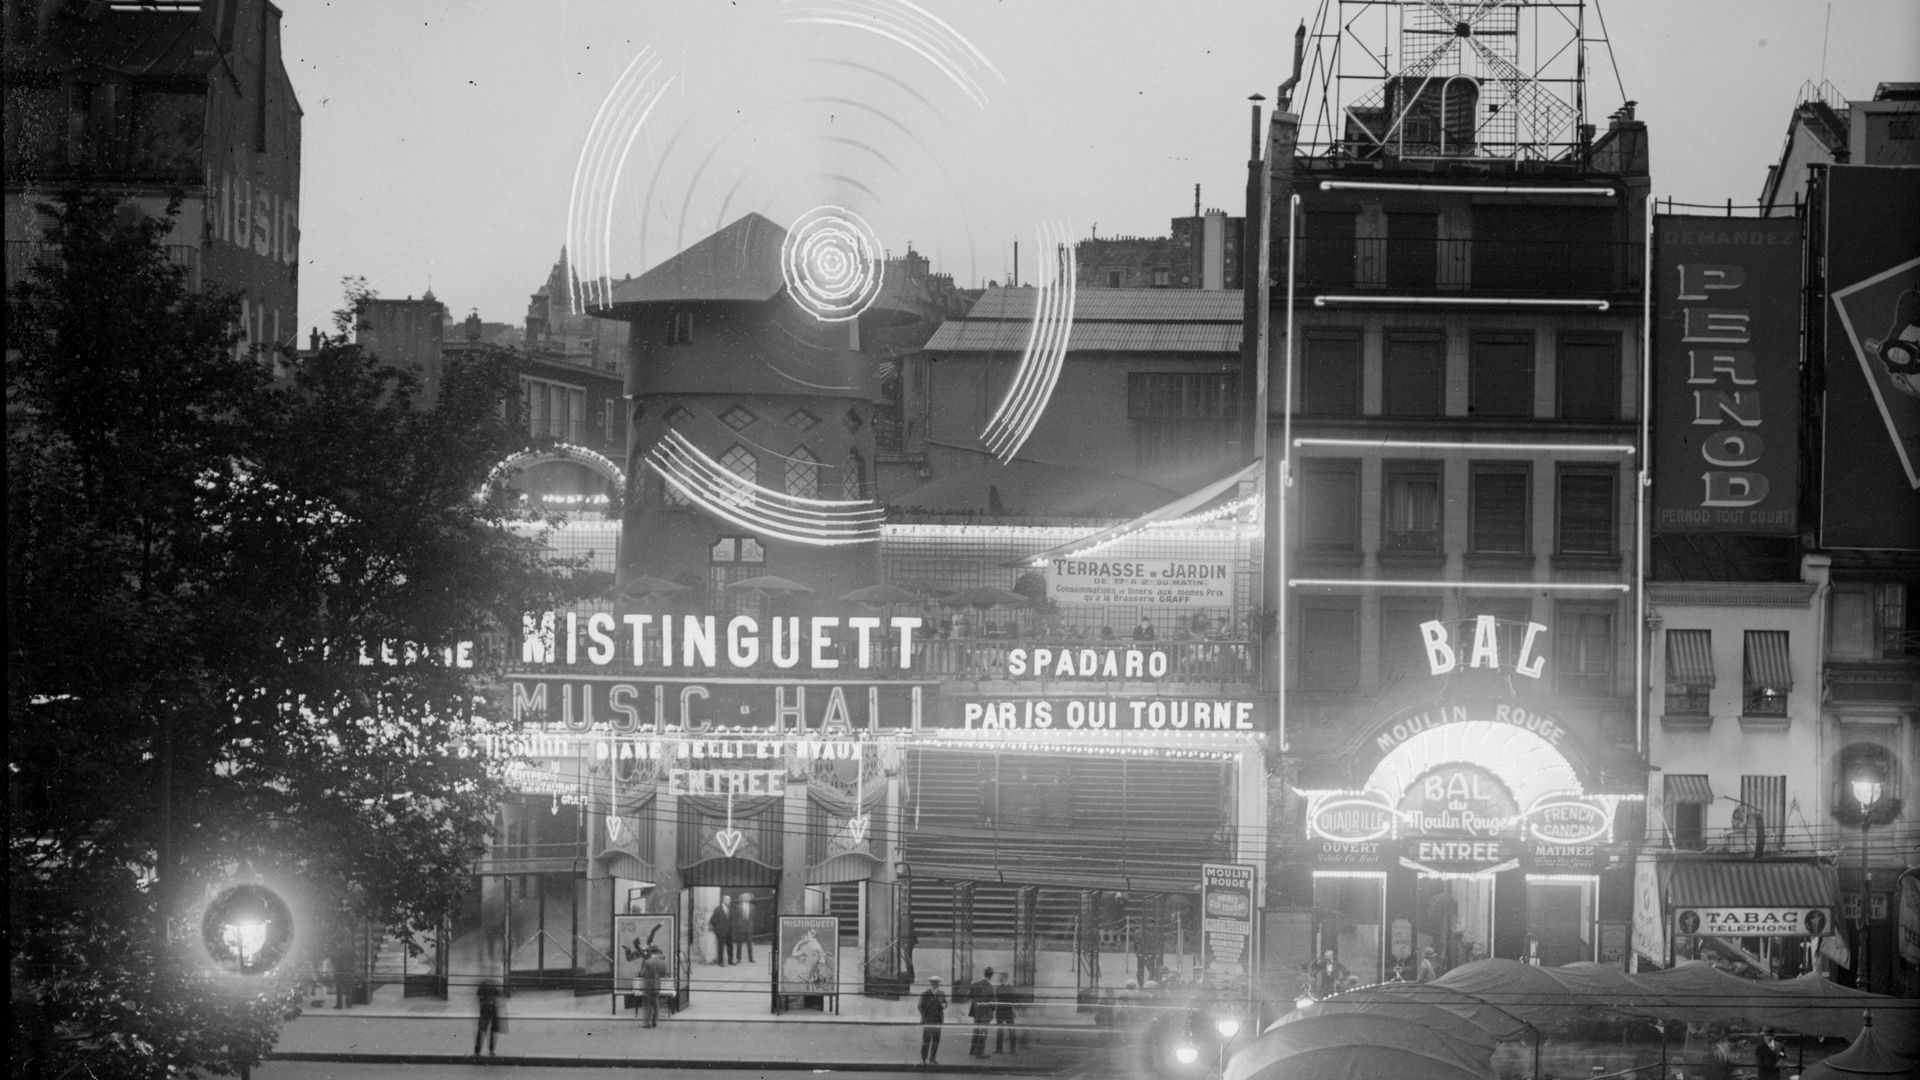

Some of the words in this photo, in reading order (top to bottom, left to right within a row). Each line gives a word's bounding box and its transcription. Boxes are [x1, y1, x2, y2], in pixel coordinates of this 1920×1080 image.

[1677, 263, 1769, 507] PERNOD
[1052, 558, 1144, 578] TERRASSE
[1162, 561, 1226, 580] JARDIN
[1056, 584, 1117, 595] Consommations
[1206, 588, 1224, 597] Prix
[1159, 595, 1191, 604] GRAFF
[523, 611, 922, 669] MISTINGUETT
[1420, 615, 1548, 679] BAL
[1008, 649, 1168, 678] SPADARO
[512, 682, 711, 735] MUSIC
[775, 686, 940, 735] HALL
[965, 702, 1052, 729] PARIS
[1130, 703, 1254, 730] TOURNE
[1377, 705, 1468, 752] MOULIN
[1496, 704, 1565, 745] ROUGE
[596, 741, 662, 760] DIANE
[756, 742, 782, 758] ET
[669, 769, 787, 797] ENTREE
[1424, 773, 1492, 801] BAL
[1447, 799, 1467, 811] du
[1407, 810, 1461, 834] Moulin
[1461, 810, 1508, 836] Rouge
[1543, 807, 1595, 823] FRENCH
[1543, 823, 1595, 838] CANCAN
[1322, 842, 1380, 854] OUVERT
[1419, 842, 1500, 861] ENTREE
[1206, 868, 1249, 880] MOULIN
[1211, 878, 1245, 888] ROUGE
[783, 919, 834, 928] MISTINGUETT
[1705, 912, 1797, 924] TABAC
